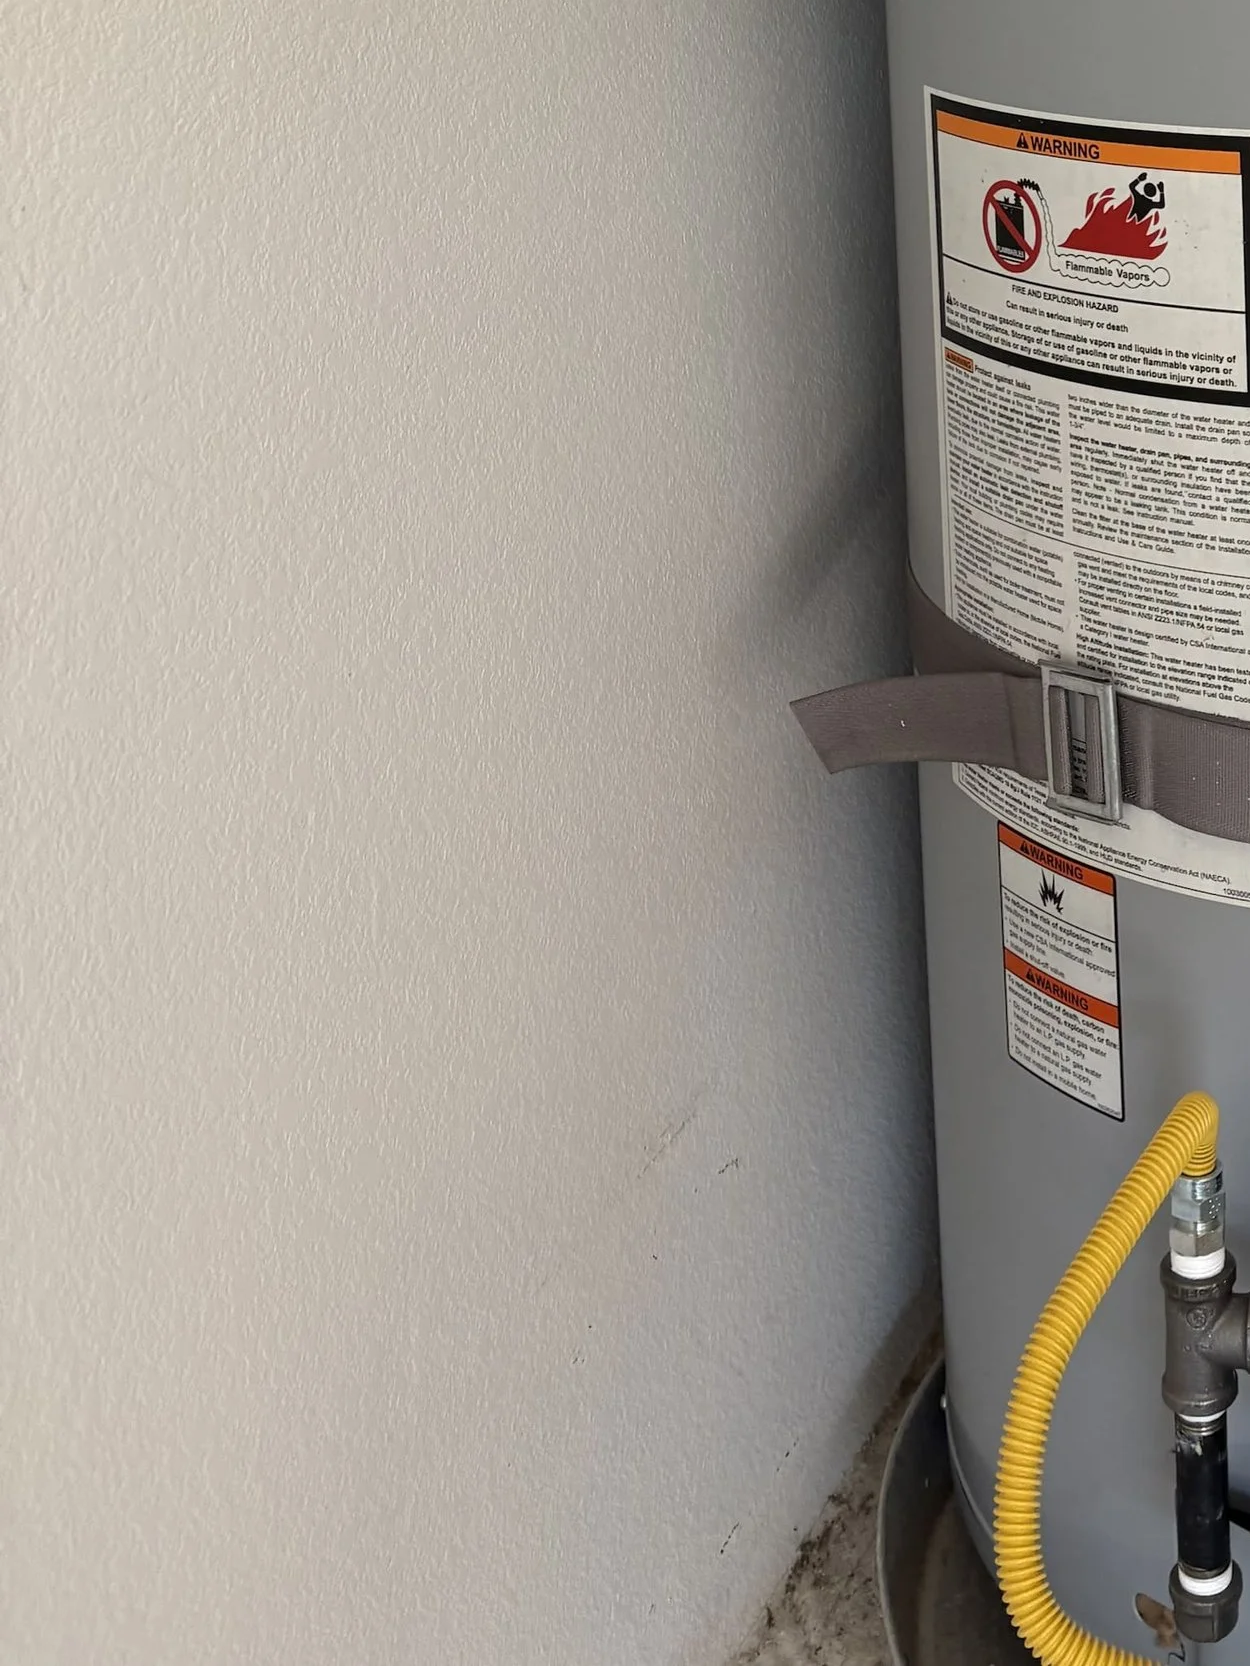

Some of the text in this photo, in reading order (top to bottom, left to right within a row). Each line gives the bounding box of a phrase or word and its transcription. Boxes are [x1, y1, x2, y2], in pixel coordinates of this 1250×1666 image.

[1030, 136, 1100, 159] WARNING
[1066, 261, 1150, 282] Flammable Vapors
[1012, 285, 1118, 313] FIRE AND EXPLOSION HAZARD
[1029, 845, 1083, 881] WARNING
[1035, 974, 1088, 1011] WARNING
